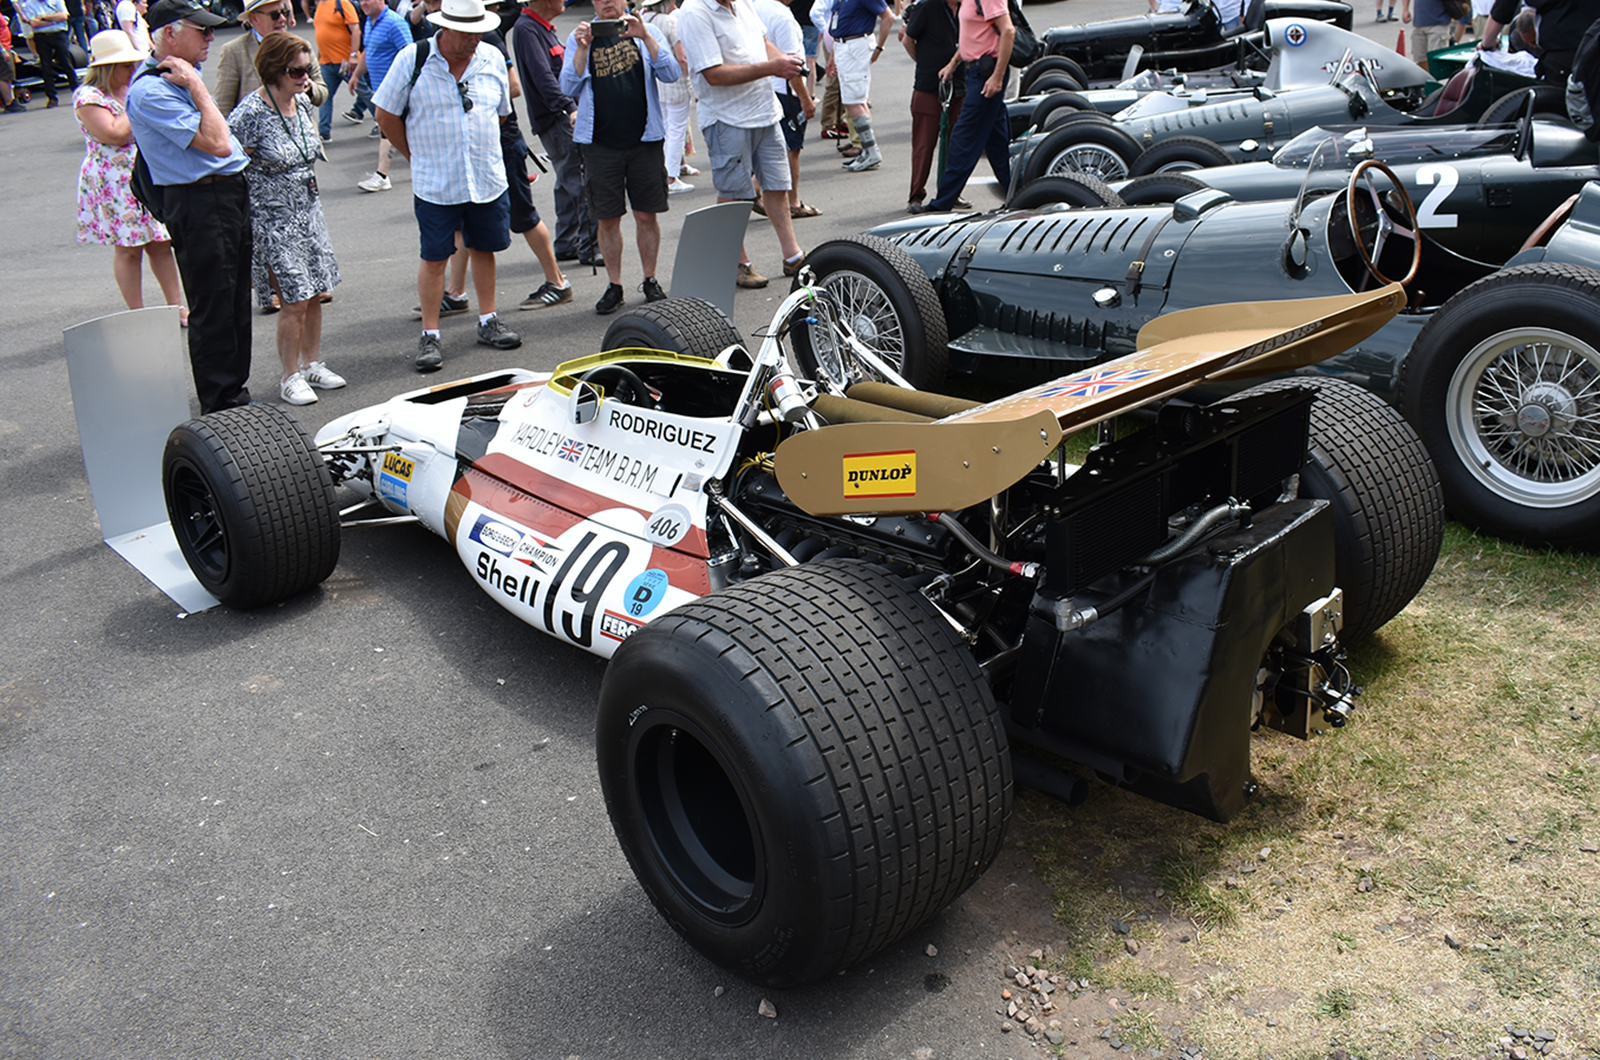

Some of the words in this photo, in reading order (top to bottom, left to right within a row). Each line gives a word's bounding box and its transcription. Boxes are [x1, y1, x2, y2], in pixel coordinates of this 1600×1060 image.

[1415, 164, 1459, 228] 2
[609, 409, 717, 454] RODRIGUEZ
[510, 422, 566, 457] YARDLEY
[579, 443, 617, 477] TEAM
[384, 454, 412, 478] LUCAS
[848, 468, 912, 482] DUNLOP
[650, 516, 681, 540] 406
[519, 542, 559, 567] CHAMPION
[477, 551, 541, 608] Shell
[543, 531, 630, 648] 19
[633, 586, 652, 603] D
[630, 602, 643, 616] 19
[602, 615, 638, 638] FERO
